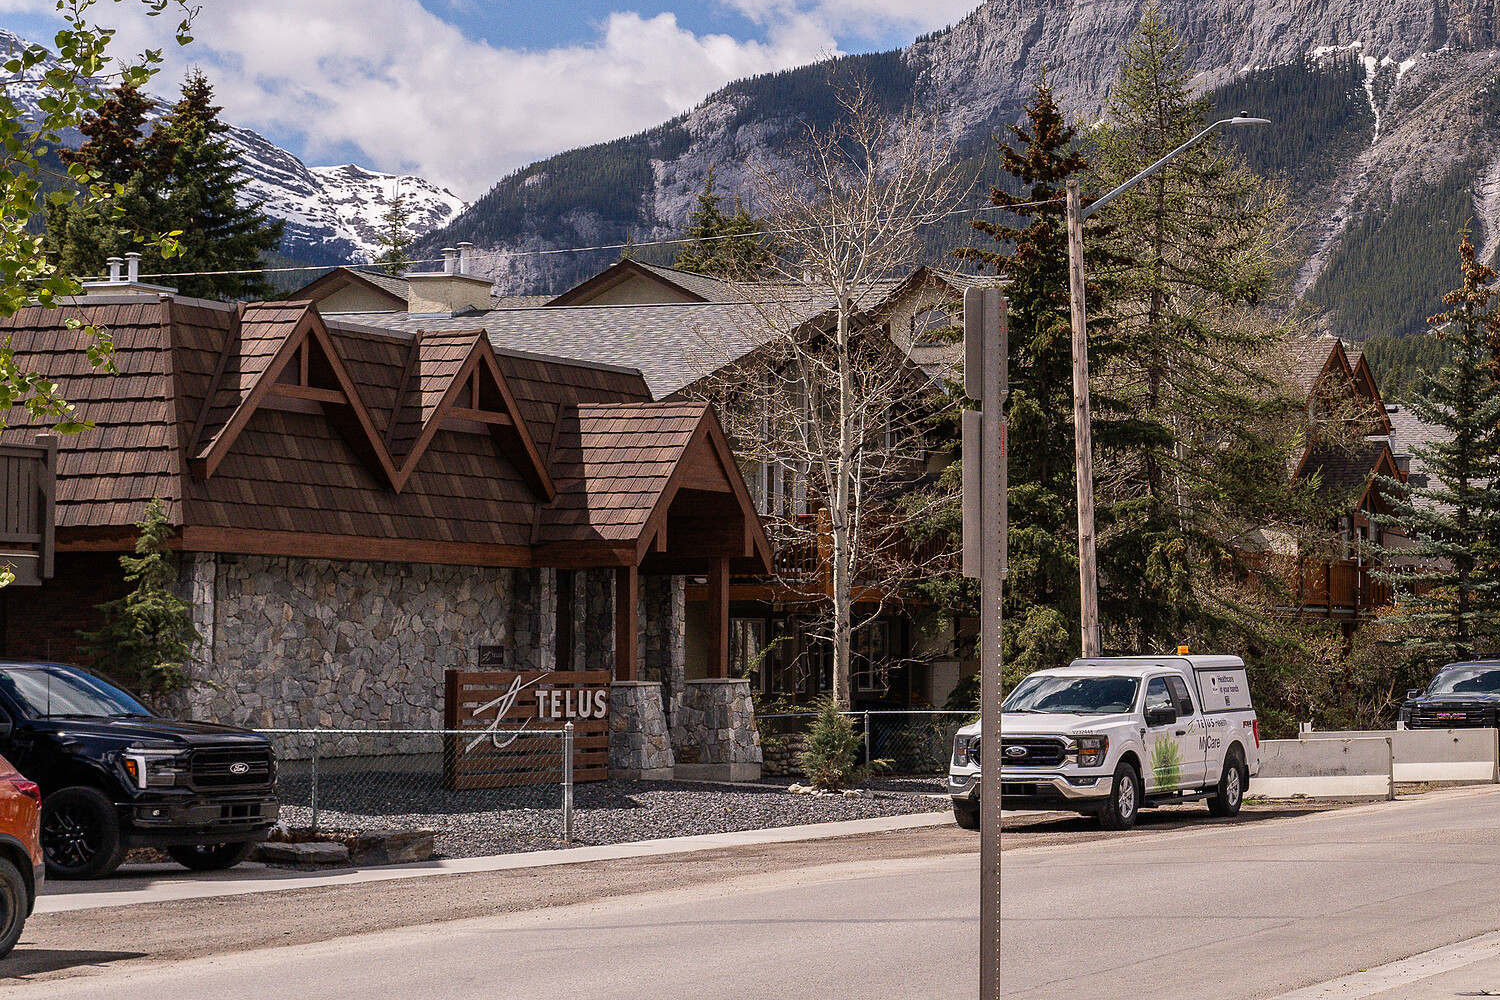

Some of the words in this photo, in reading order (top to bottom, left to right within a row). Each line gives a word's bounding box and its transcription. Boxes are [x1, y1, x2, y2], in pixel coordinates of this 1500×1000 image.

[534, 689, 607, 719] TELUS
[1436, 712, 1467, 720] GMC
[1198, 735, 1221, 753] MyCare
